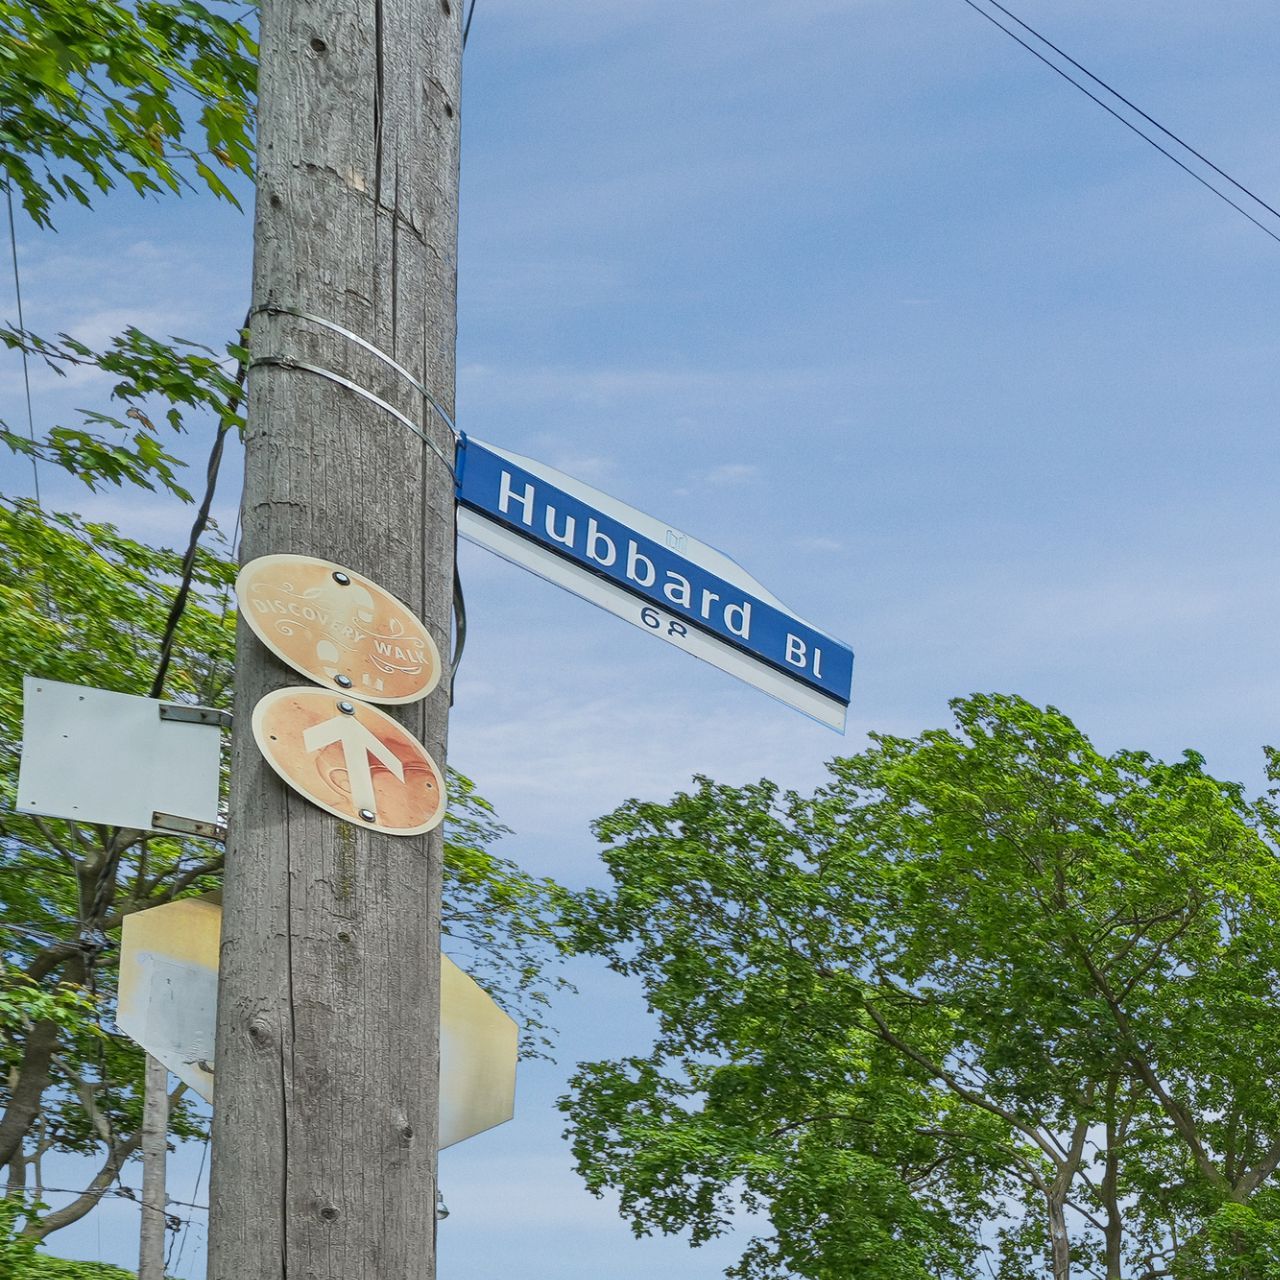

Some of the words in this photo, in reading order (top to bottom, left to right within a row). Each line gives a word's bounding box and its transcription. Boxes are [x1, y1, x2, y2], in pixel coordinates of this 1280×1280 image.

[252, 600, 365, 643] DISCOVERY
[373, 640, 429, 664] WALK
[498, 470, 751, 640] Hubbard
[785, 633, 823, 679] Bl
